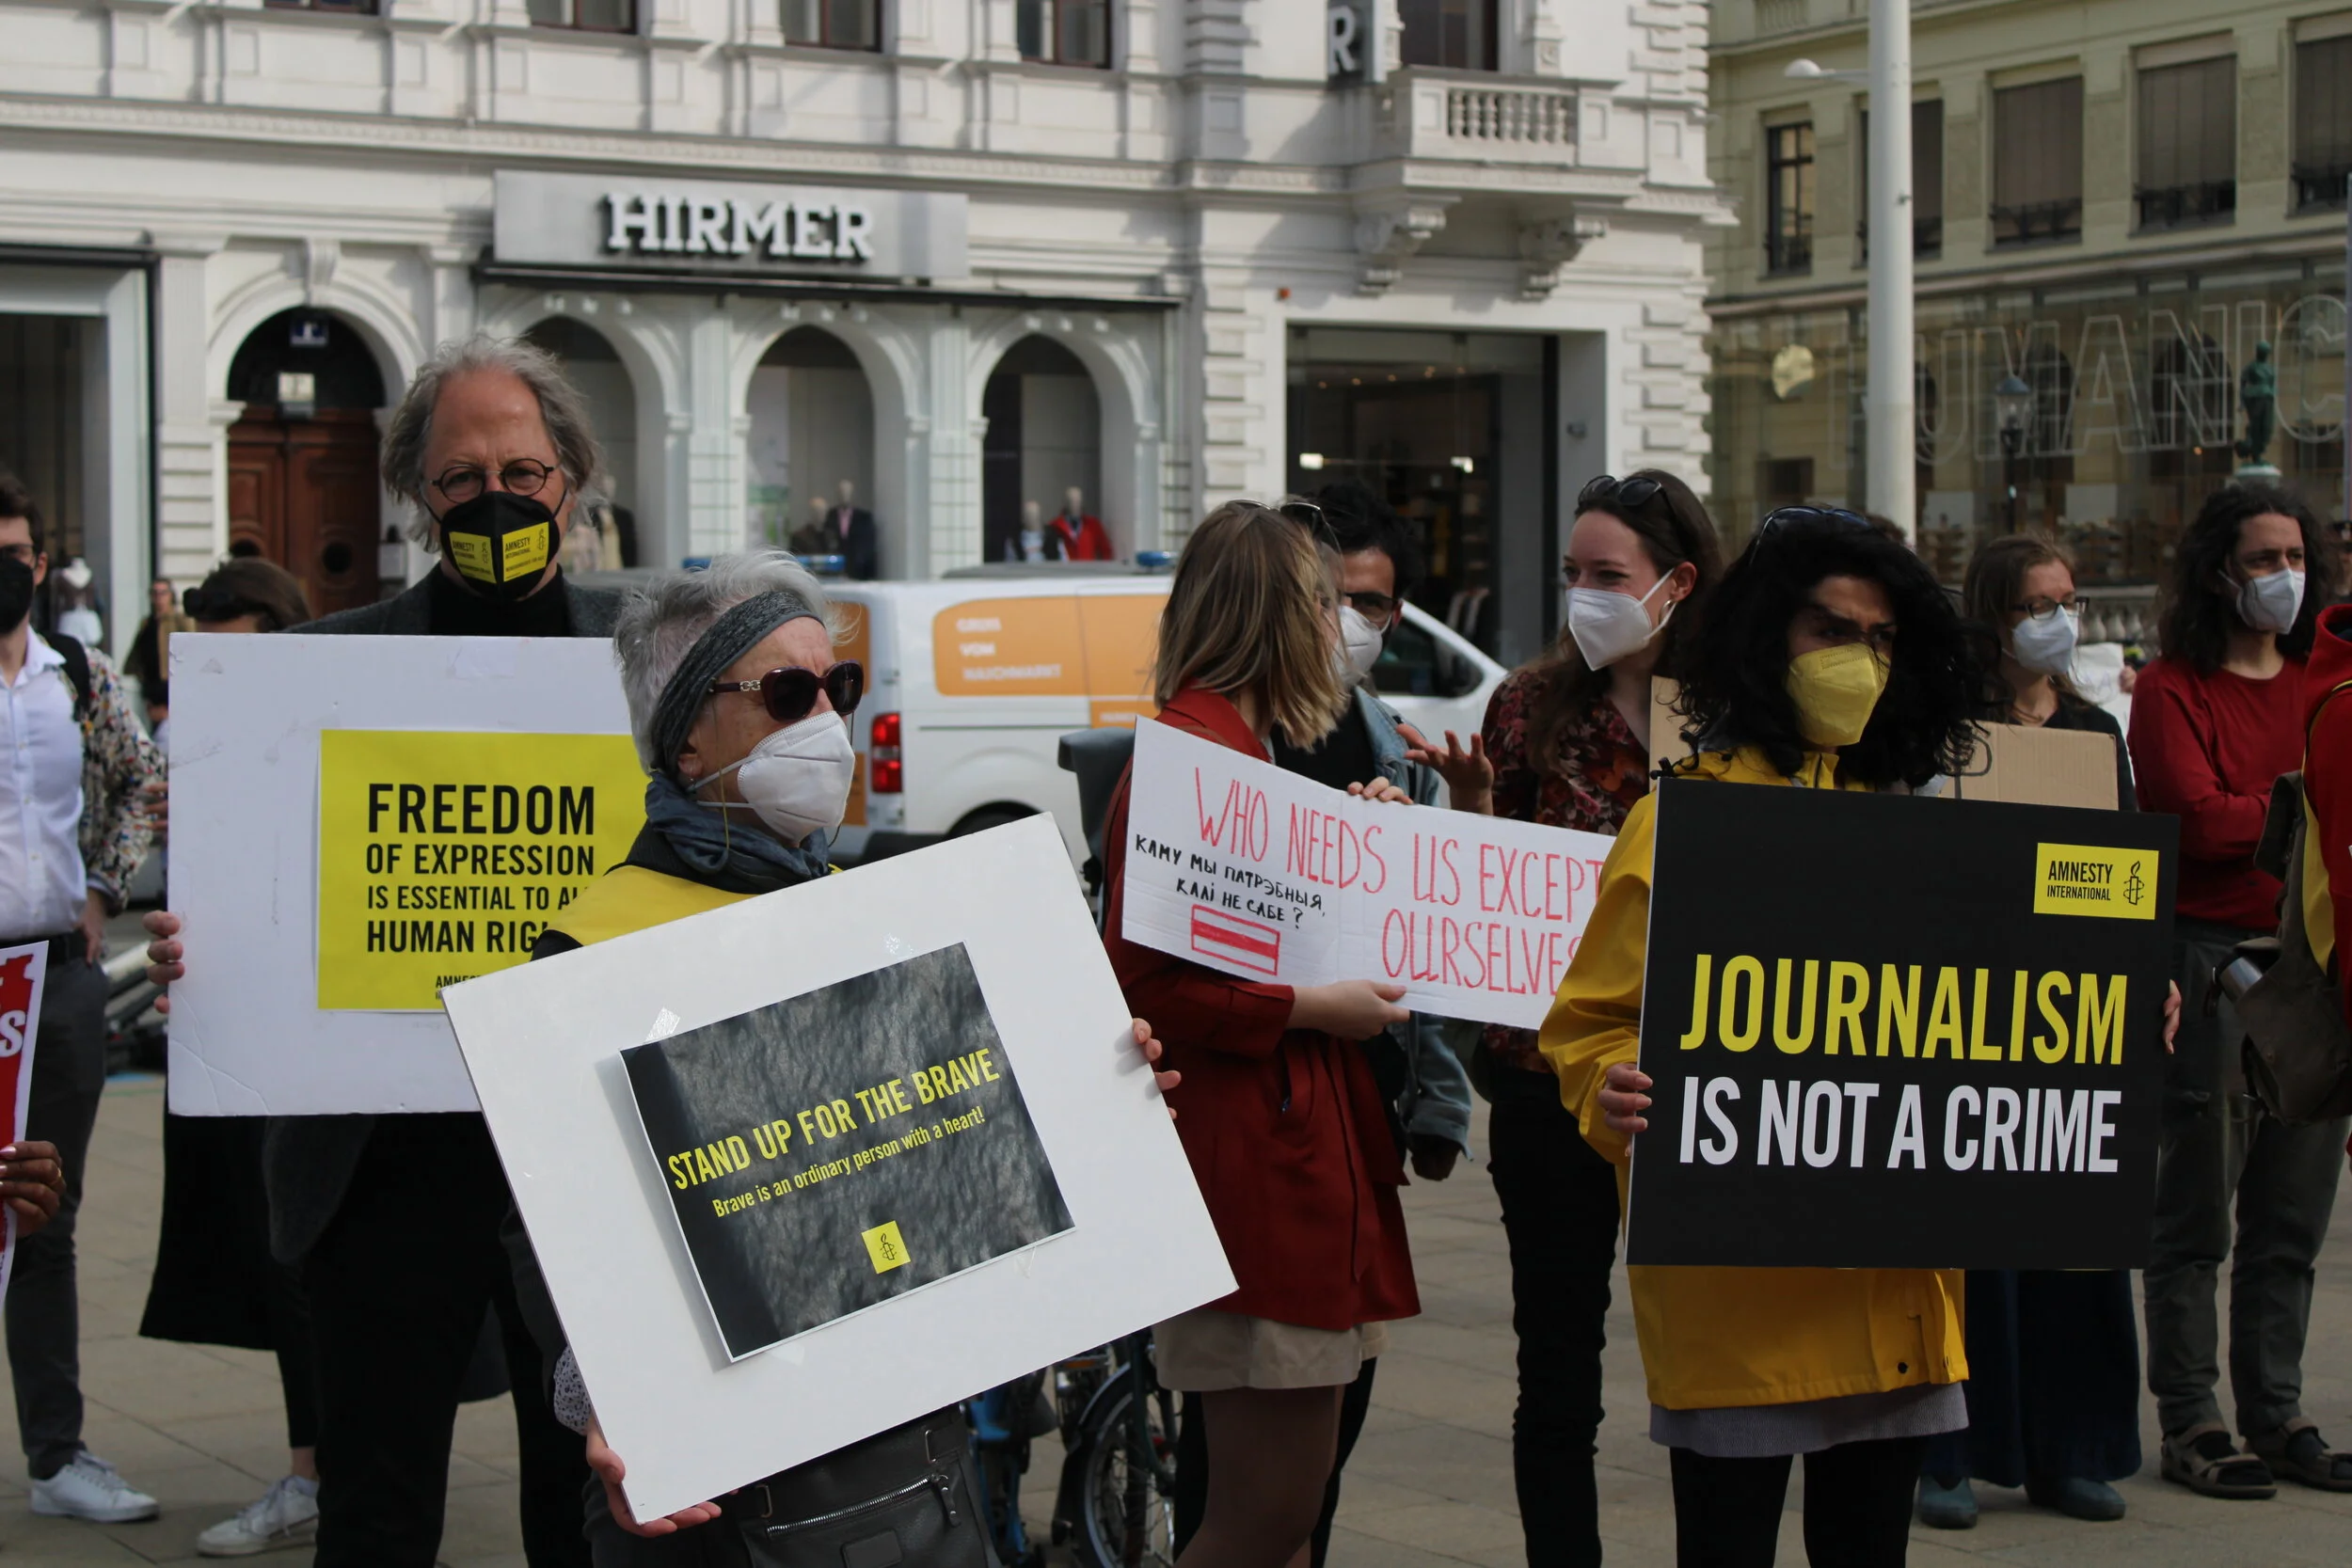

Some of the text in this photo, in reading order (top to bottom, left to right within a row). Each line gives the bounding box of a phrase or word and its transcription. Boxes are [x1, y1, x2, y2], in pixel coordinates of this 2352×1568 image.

[607, 191, 876, 261] HIRMER
[368, 783, 595, 835] FREEDOM
[366, 843, 595, 876] OF EXPRESSION
[1136, 833, 1182, 864] КАМУ
[1190, 853, 1216, 876] МЫ
[1195, 767, 1605, 923] WHO NEEDS US EXCEPT
[2046, 885, 2111, 901] INTERNATIONAL
[2047, 861, 2113, 884] AMNESTY
[367, 885, 389, 910] IS
[397, 885, 516, 911] ESSENTIAL
[522, 886, 549, 911] TO
[1222, 892, 1242, 910] НЕ
[367, 920, 474, 953] HUMAN
[1679, 953, 2128, 1065] JOURNALISM
[668, 1048, 1001, 1190] STAND UP FOR THE BRAVE
[1679, 1076, 2122, 1173] IS NOT A CRIME
[712, 1106, 986, 1218] Brave is an ordinary person with a heart!
